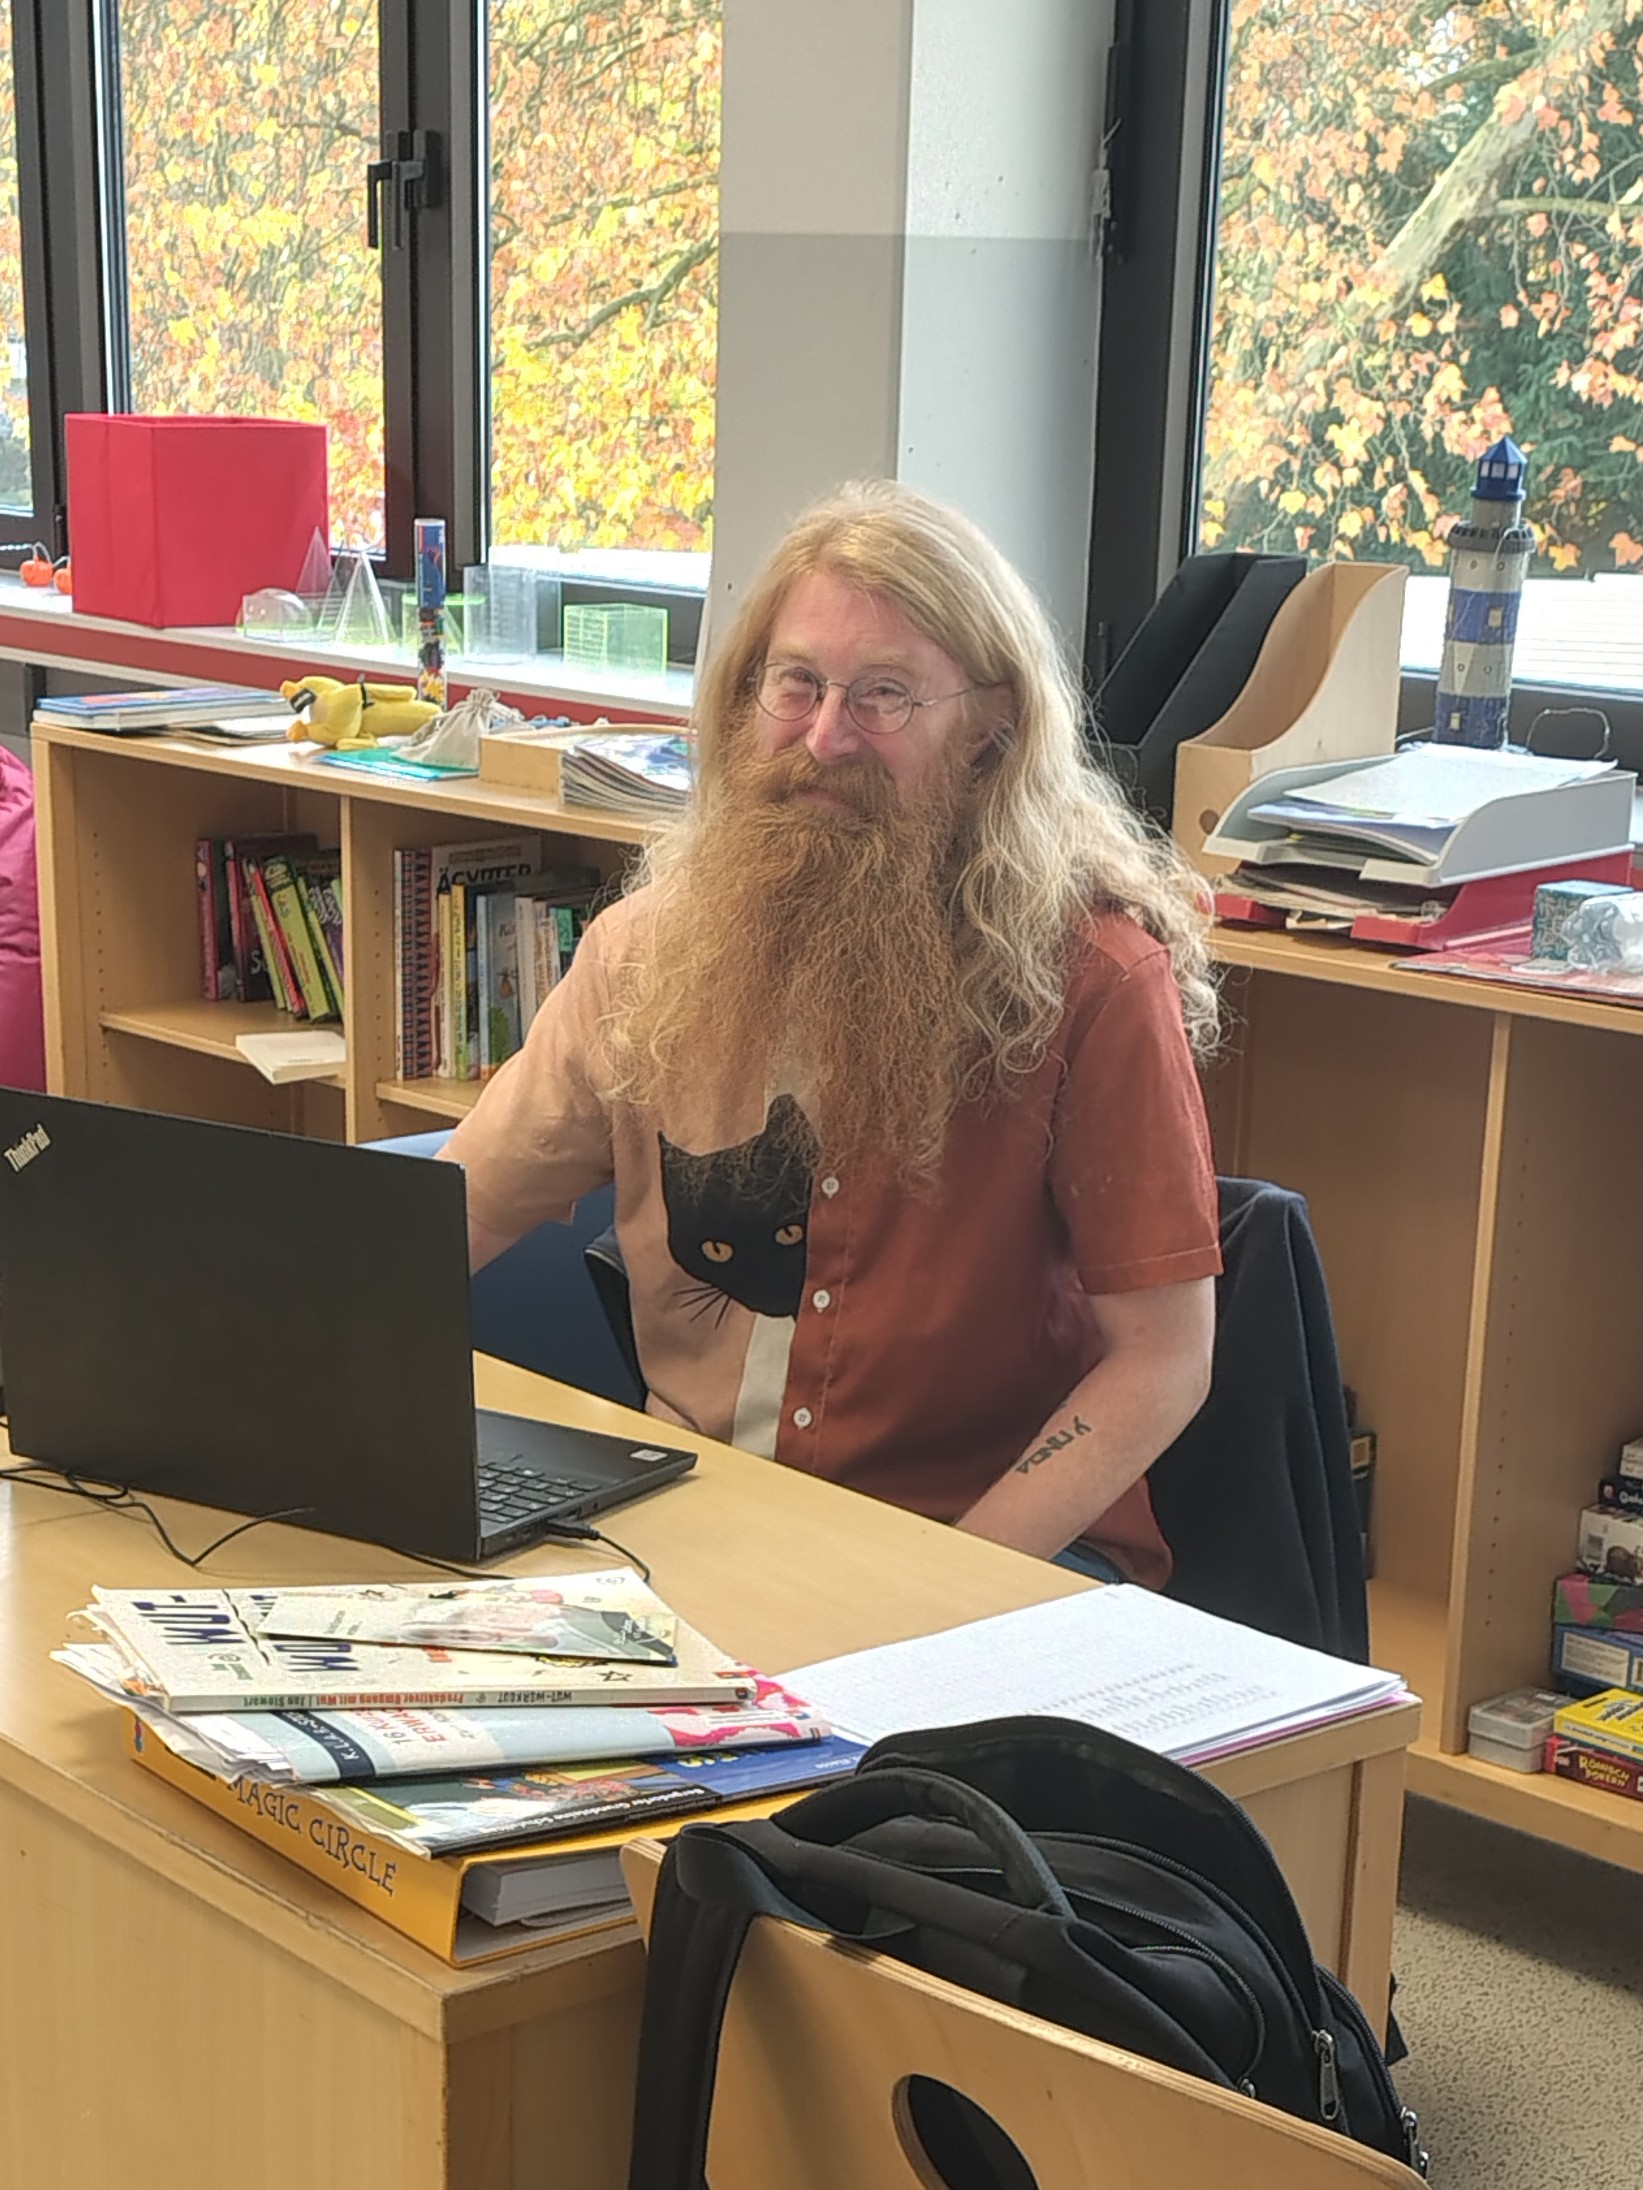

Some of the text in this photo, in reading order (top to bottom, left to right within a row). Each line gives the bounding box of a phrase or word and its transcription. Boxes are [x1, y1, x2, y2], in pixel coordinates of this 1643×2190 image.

[4, 1123, 51, 1171] ThinkPad
[243, 1694, 284, 1707] Stewart
[316, 1694, 337, 1705] Wut
[339, 1694, 356, 1705] mit
[359, 1692, 400, 1705] Umgang
[383, 1732, 416, 1744] 16
[228, 1775, 397, 1897] MAGIC CIRCLE
